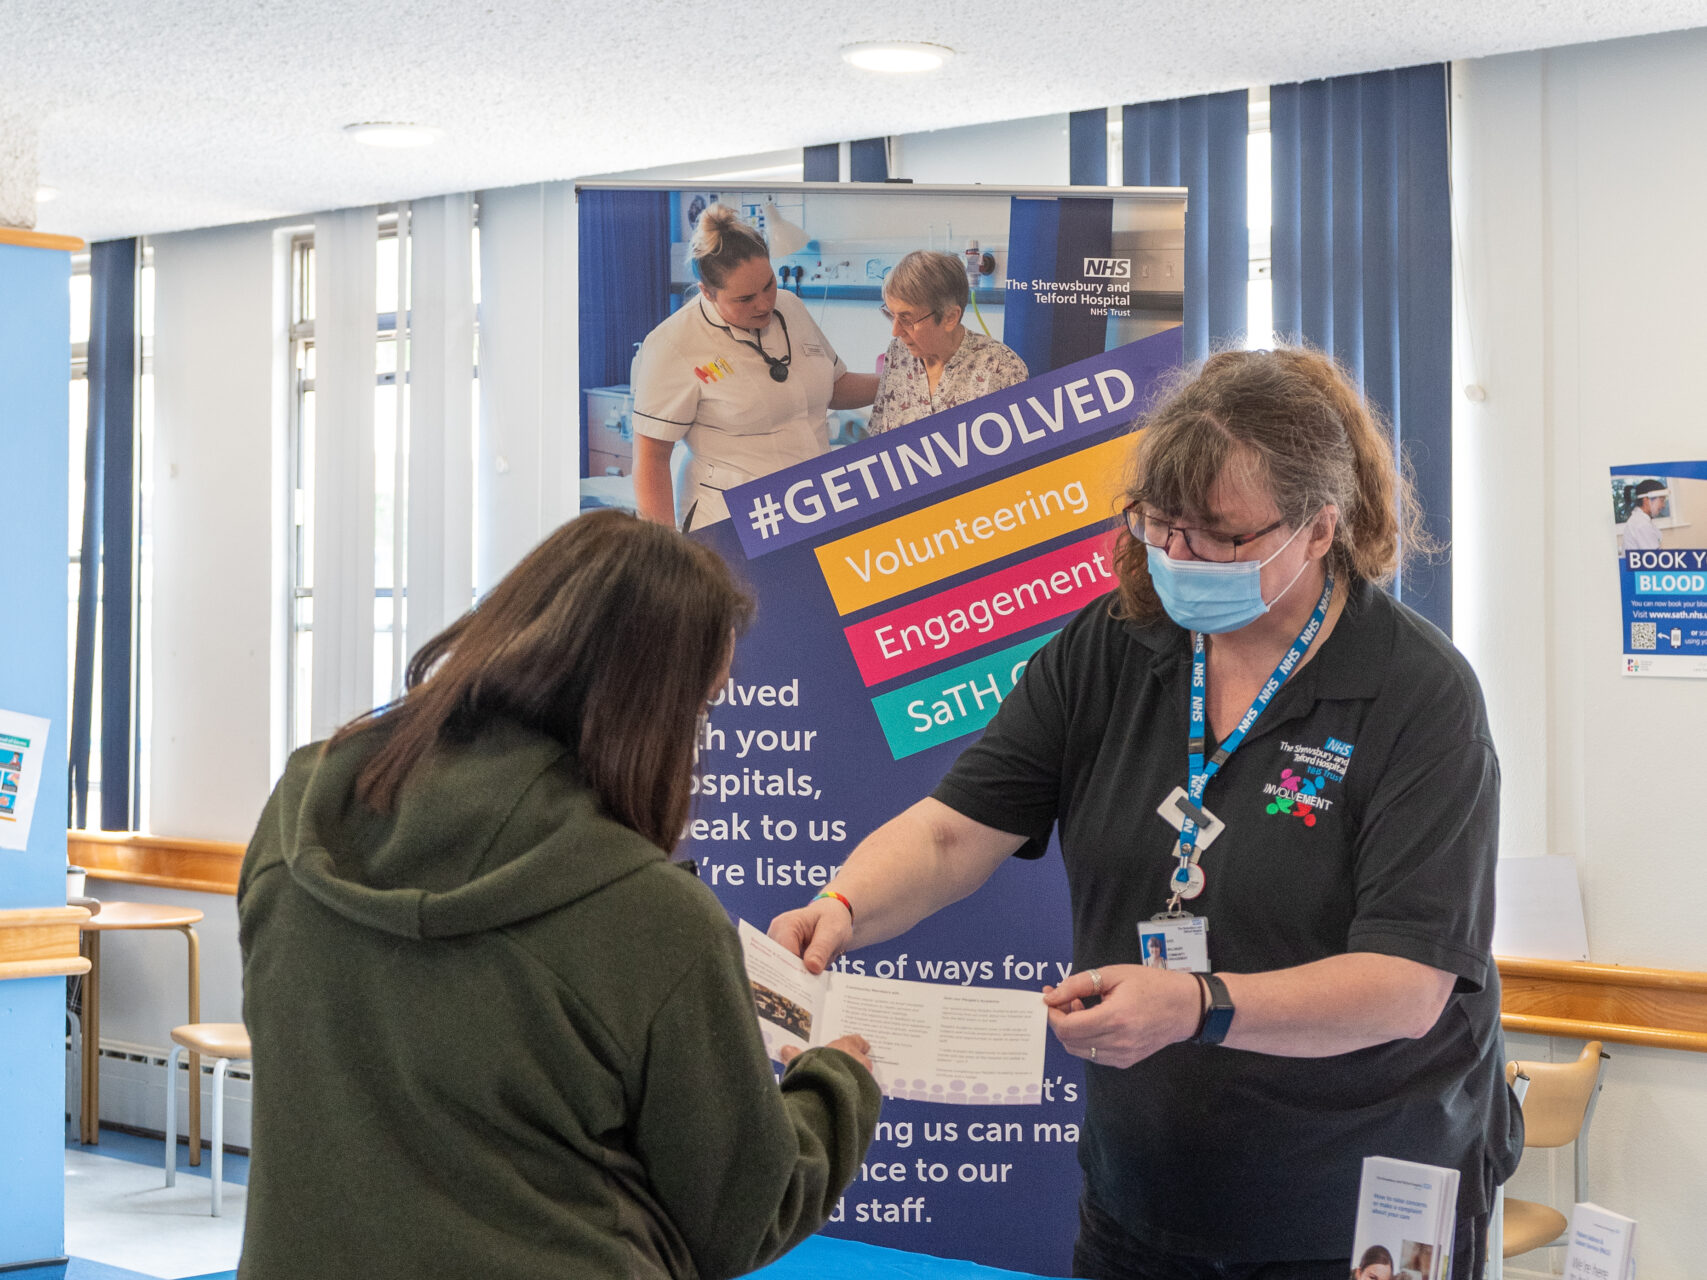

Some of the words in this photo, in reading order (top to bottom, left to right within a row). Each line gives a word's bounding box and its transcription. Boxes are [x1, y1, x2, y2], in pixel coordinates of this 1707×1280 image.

[1085, 259, 1129, 276] NHS
[1005, 279, 1028, 290] The
[1032, 279, 1103, 294] Shrewsbury
[1107, 281, 1130, 293] and
[1034, 292, 1077, 304] Telford
[1081, 294, 1130, 307] Hospital
[1090, 308, 1108, 316] NHS
[1110, 308, 1131, 317] Trust
[748, 368, 1136, 540] #GETINVOLVED
[845, 476, 1089, 583] Volunteering
[1629, 551, 1688, 569] BOOK
[1640, 575, 1705, 592] BLOOD
[874, 551, 1112, 659] Engagement
[1318, 587, 1332, 615] NHS
[1632, 610, 1648, 618] Visit
[1300, 618, 1320, 646] NHS
[1279, 647, 1301, 675] NHS
[1193, 662, 1204, 687] NHS
[906, 673, 1003, 733] SaTH
[1258, 677, 1280, 704] NHS
[1192, 696, 1203, 722] NHS
[1237, 707, 1259, 734] NHS
[736, 729, 817, 758] your
[1280, 741, 1293, 752] The
[1334, 756, 1349, 767] and
[1328, 739, 1353, 756] NHS
[1293, 754, 1316, 764] Telford
[1316, 758, 1347, 776] Hospital
[1306, 766, 1322, 776] NHS
[1324, 771, 1343, 784] Trust
[1263, 783, 1333, 811] INVOLVEMENT
[760, 814, 797, 841] to
[808, 819, 847, 842] us
[875, 954, 908, 979] of
[916, 961, 994, 986] ways
[1003, 955, 1048, 981] for
[1042, 1076, 1078, 1102] t's
[924, 1122, 958, 1142] us
[967, 1121, 1023, 1142] can
[1034, 1122, 1080, 1142] ma
[916, 1158, 948, 1182] to
[958, 1164, 1013, 1183] our
[855, 1197, 932, 1223] staff.
